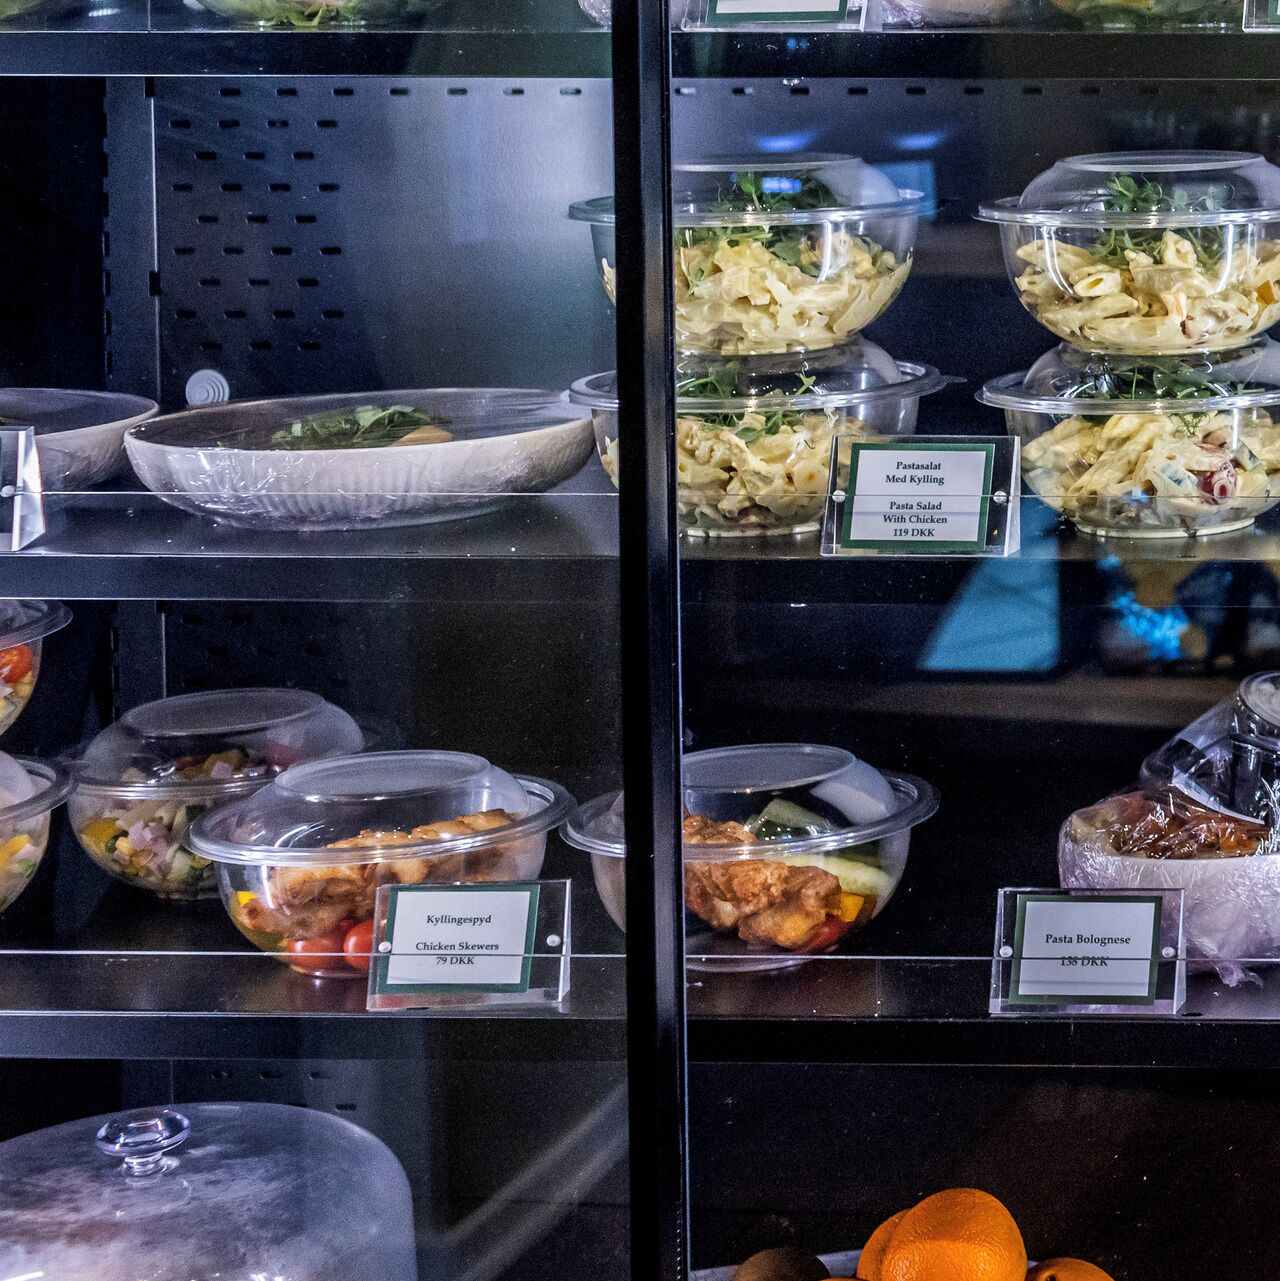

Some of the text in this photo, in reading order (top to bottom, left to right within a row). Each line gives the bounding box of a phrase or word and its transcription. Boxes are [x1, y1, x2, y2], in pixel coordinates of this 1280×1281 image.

[896, 462, 942, 471] Pastasalat
[886, 474, 945, 486] Med Kylling
[890, 501, 942, 510] Pasta Salad
[883, 515, 948, 524] With Chicken
[893, 528, 935, 537] 119 DKK
[427, 914, 492, 926] Kyllingespyd
[1045, 933, 1131, 947] Pasta Bolognese
[415, 941, 500, 951] Chicken Skewers
[436, 956, 475, 965] 79 DKK
[1060, 957, 1109, 967] 138 DKK
